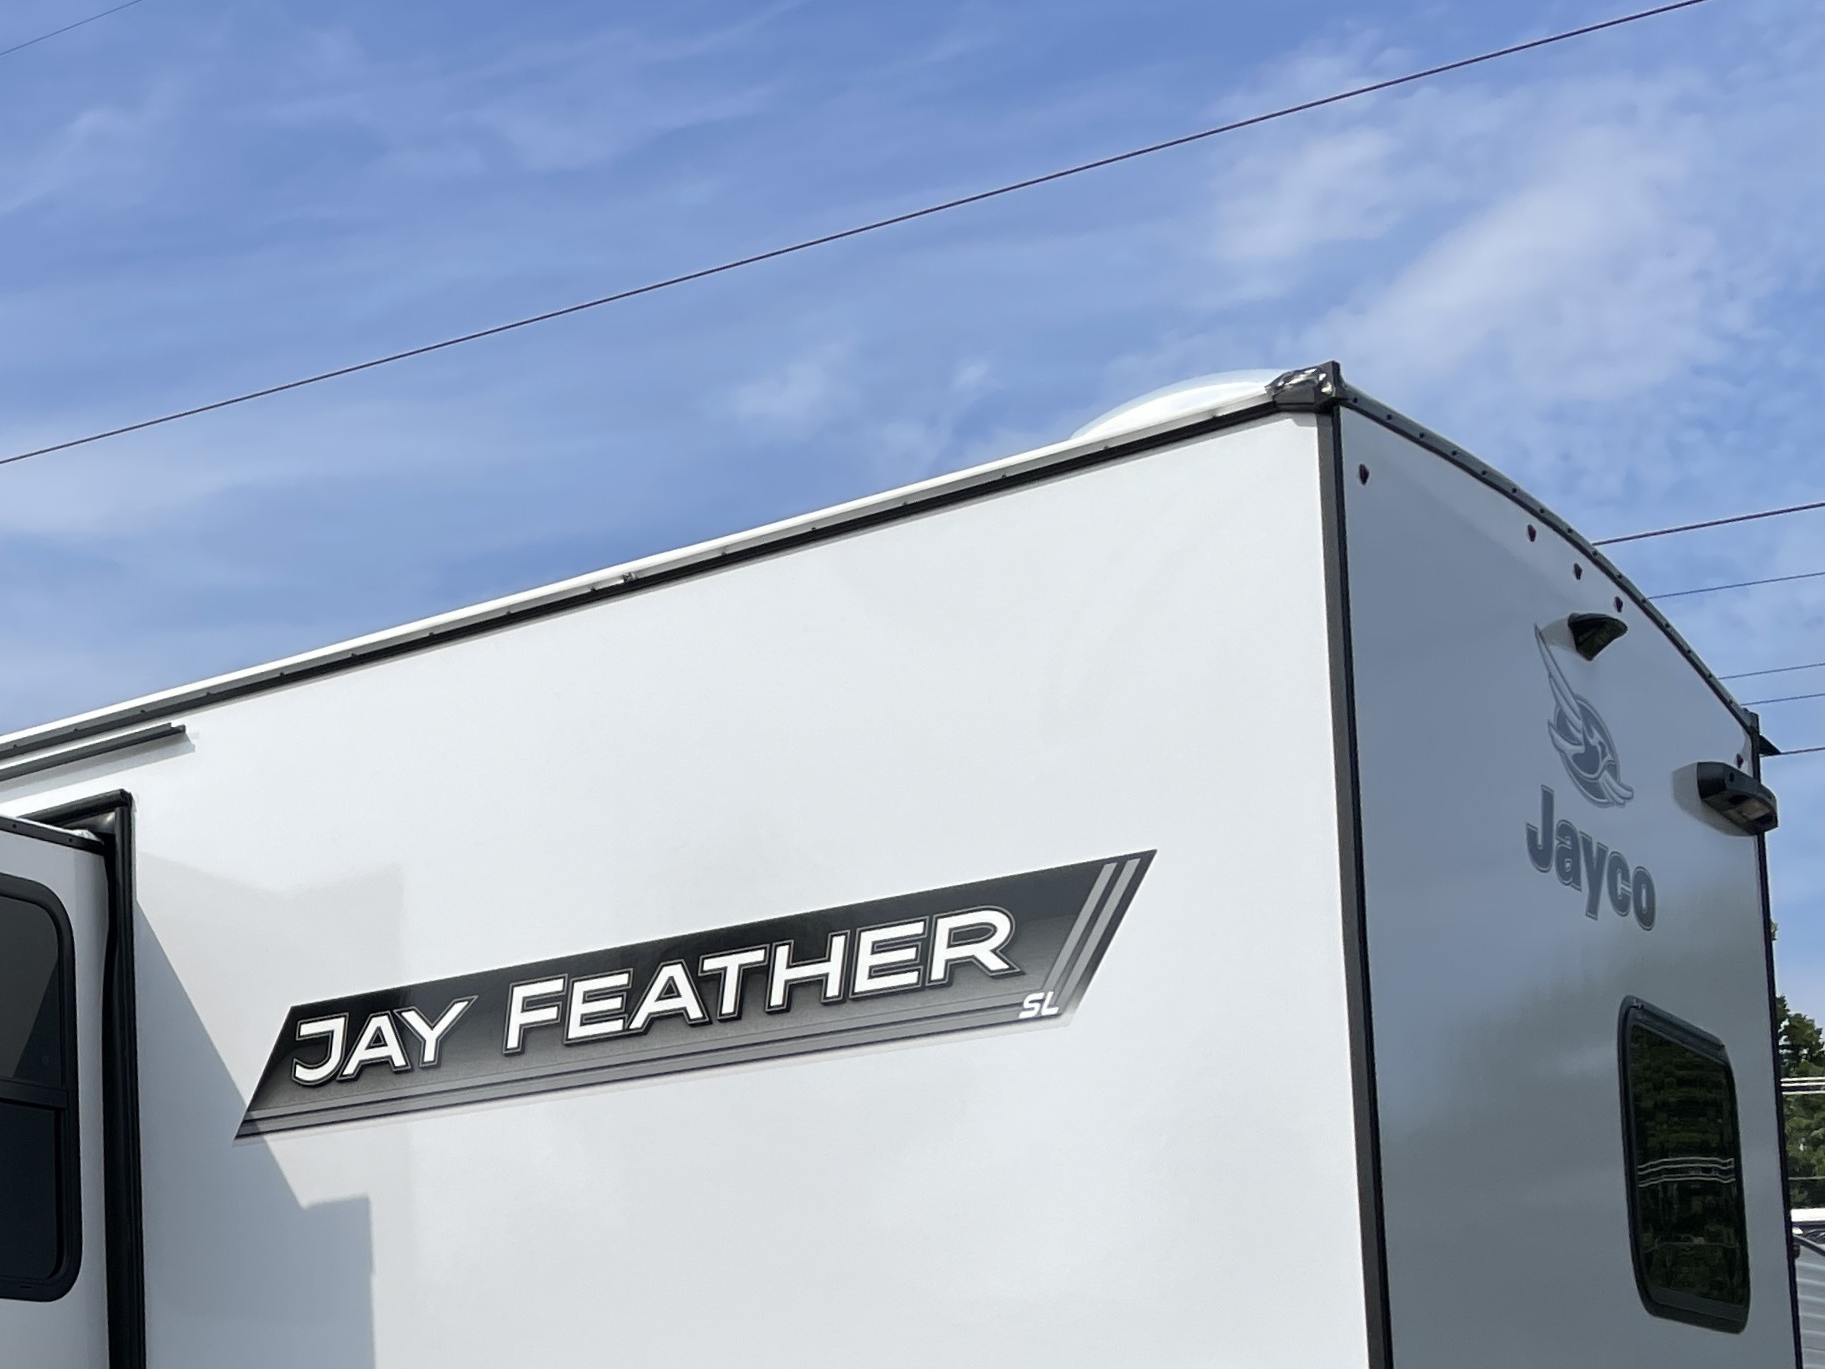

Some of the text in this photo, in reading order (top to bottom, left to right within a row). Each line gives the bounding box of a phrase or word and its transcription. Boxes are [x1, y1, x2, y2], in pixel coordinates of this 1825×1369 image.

[1526, 784, 1656, 931] Jayco
[292, 906, 1025, 1086] JAY FEATHER
[1018, 991, 1059, 1019] SL
